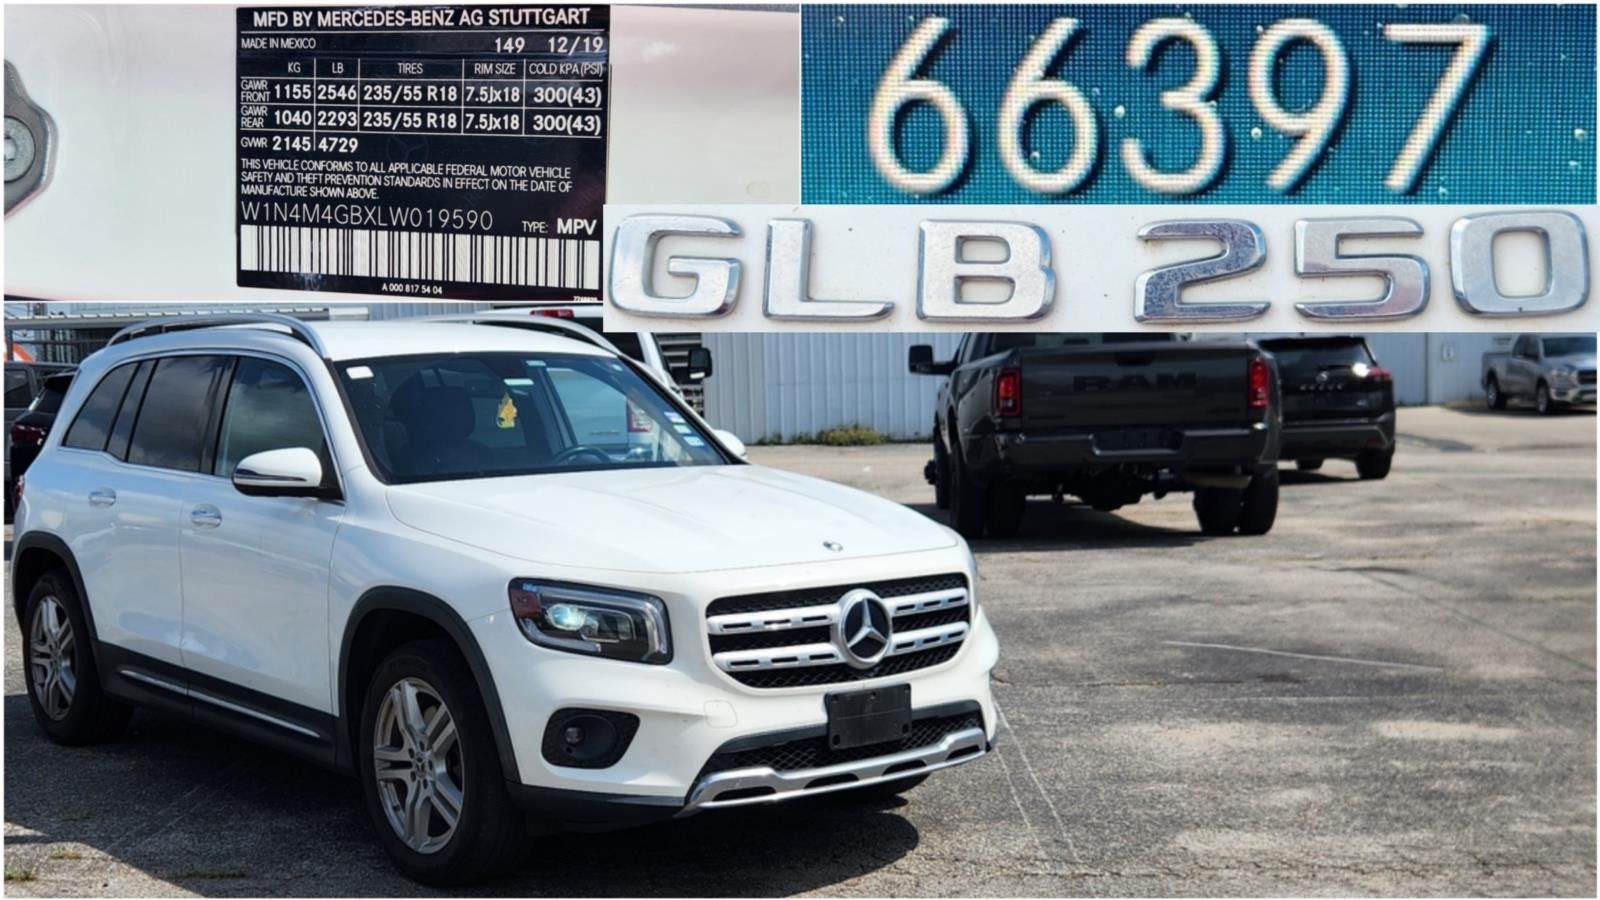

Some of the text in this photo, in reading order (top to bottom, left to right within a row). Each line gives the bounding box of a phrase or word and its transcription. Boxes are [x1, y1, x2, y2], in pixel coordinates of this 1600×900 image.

[253, 8, 590, 27] MFD BY MERCEDES-BENZ AG STUTTGART
[241, 38, 316, 49] MADE IN MEXICO
[495, 36, 604, 56] 149 12/19
[287, 62, 301, 73] KG
[331, 62, 344, 74] LB
[398, 63, 423, 74] TIRES
[474, 63, 516, 75] RIM SIZE
[529, 64, 603, 77] COLD KPA (PSI)
[240, 79, 268, 91] GAWR
[274, 84, 312, 100] 1155
[317, 85, 357, 100] 2546
[240, 91, 271, 102] FRONT
[363, 85, 457, 103] 235/55 R18
[466, 86, 520, 104] 7.5Jx18
[533, 86, 602, 107] 300(43)
[240, 106, 268, 117] GAWR
[866, 16, 1493, 197] 66397
[240, 117, 264, 128] REAR
[274, 110, 312, 126] 1040
[317, 111, 357, 127] 2293
[363, 112, 457, 130] 235/55 R18
[465, 113, 520, 131] 7.5Jx18
[532, 115, 602, 136] 300(43)
[240, 137, 268, 148] GVWR
[272, 136, 312, 151] 2145
[318, 137, 359, 153] 4729
[241, 158, 571, 179] THIS VEHICLE CONFORMS TO ALL APPLICABLE FEDERAL MOTOR VEHICLE
[240, 171, 573, 193] SAFETY AND THEFT PREVENTION STANDARDS IN EFFECT ON THE DATE OF
[241, 184, 380, 200] MANUFACTURE SHOWN ABOVE.
[241, 201, 494, 231] W1N4M4GBXLW019590
[522, 217, 597, 236] TYPE: MPV
[610, 210, 1589, 321] GLB 250
[382, 283, 442, 295] A 000 817 54 04
[1073, 373, 1197, 392] RAM
